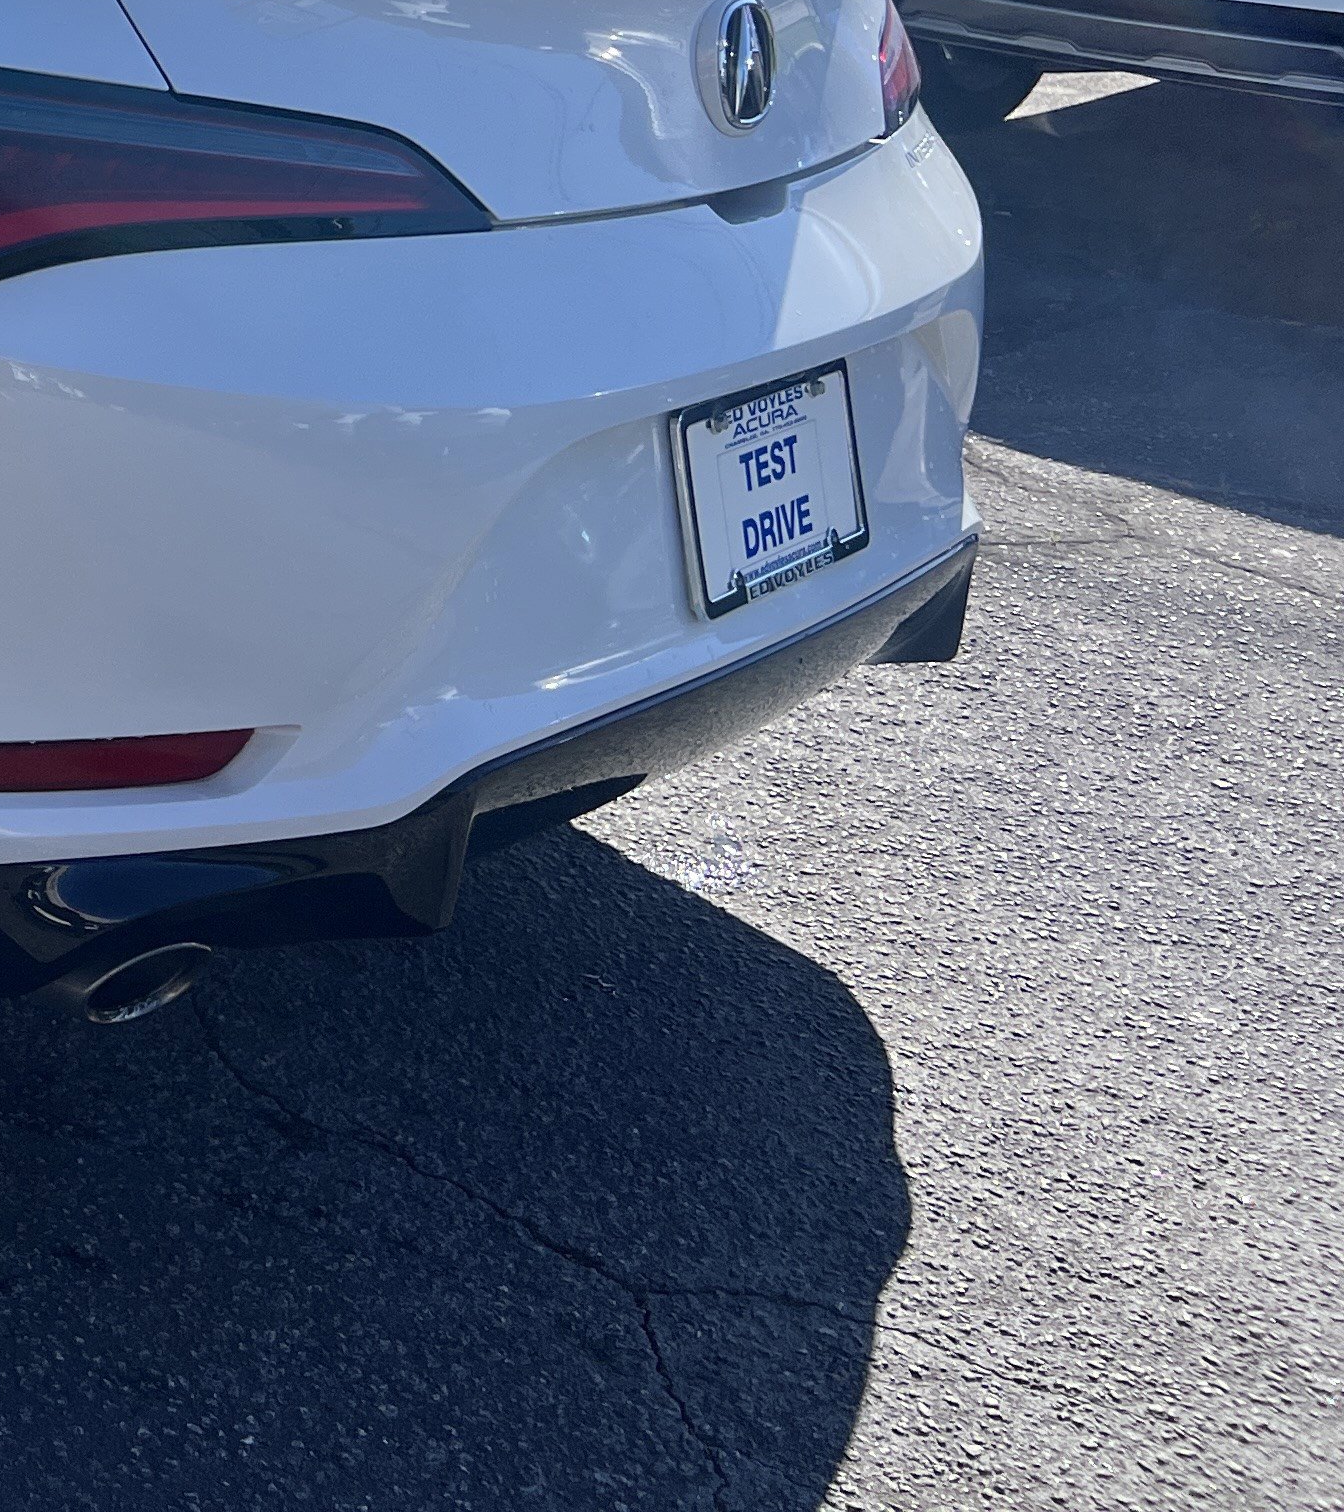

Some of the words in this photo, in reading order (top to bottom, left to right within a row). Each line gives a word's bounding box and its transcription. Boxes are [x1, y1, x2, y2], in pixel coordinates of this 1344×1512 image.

[747, 385, 804, 417] VOYLES
[732, 404, 799, 440] ACURA
[739, 435, 798, 491] TEST
[742, 494, 813, 560] DRIVE
[773, 552, 833, 588] VOYLES
